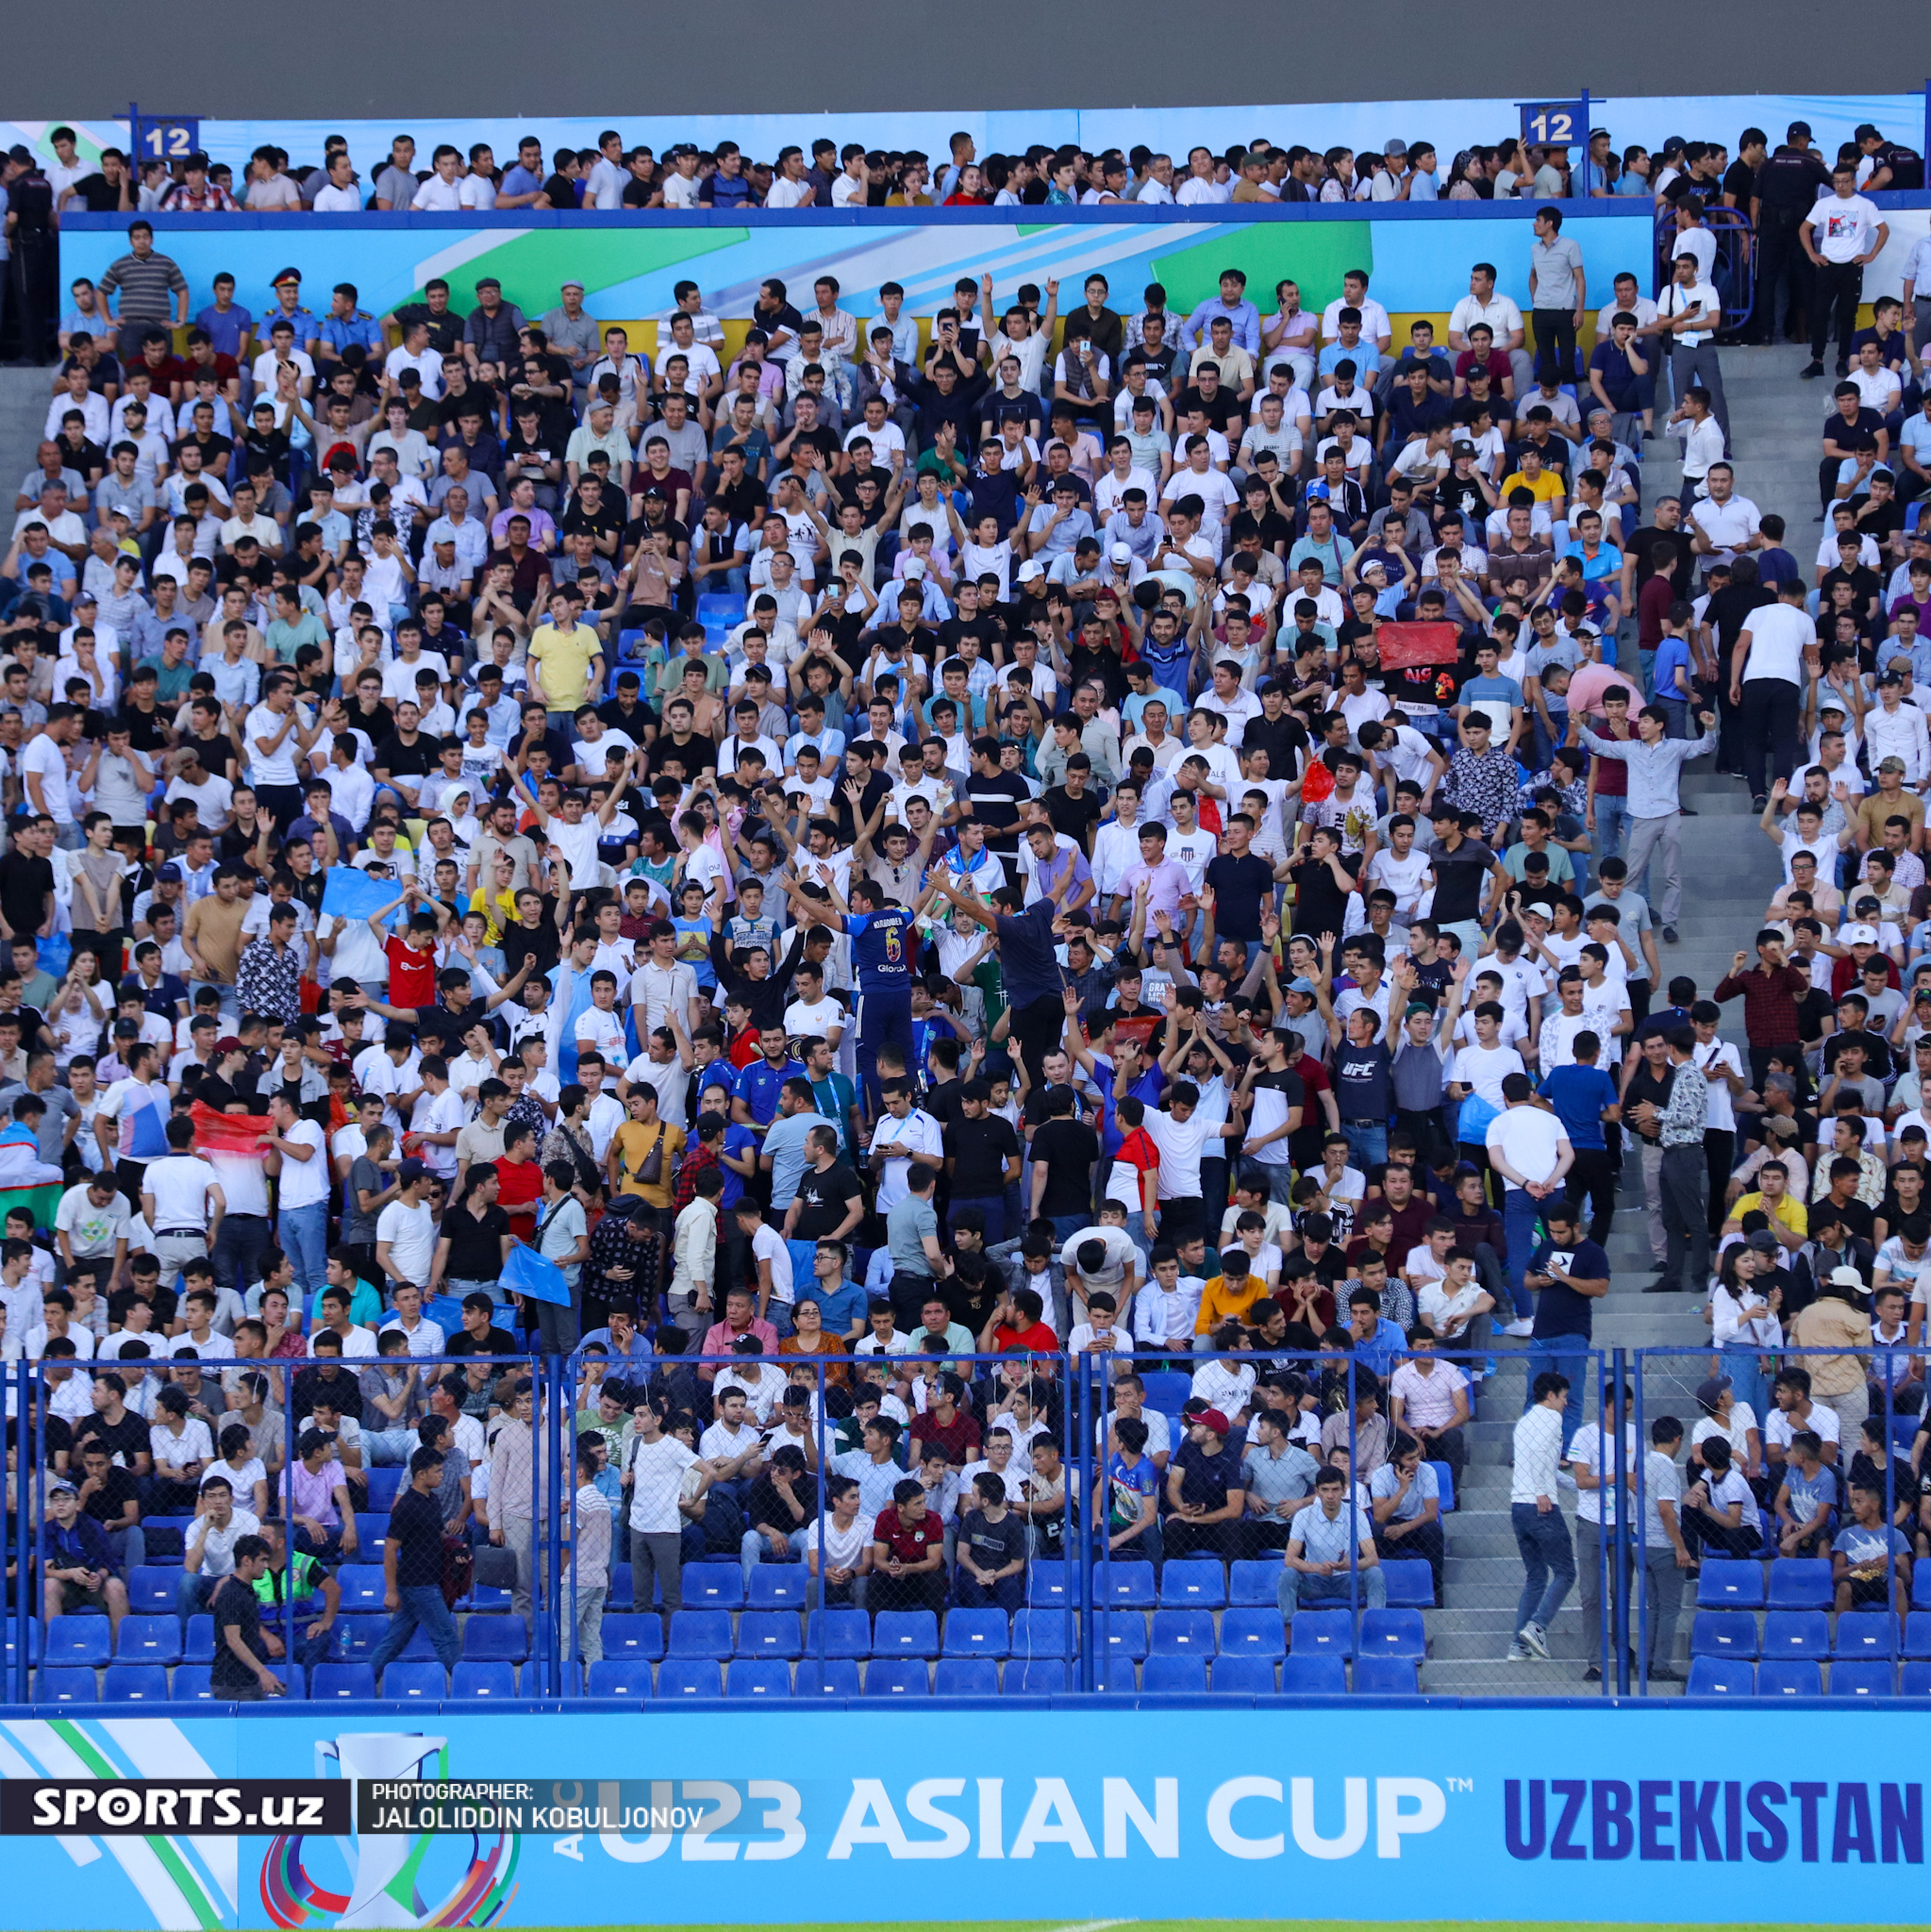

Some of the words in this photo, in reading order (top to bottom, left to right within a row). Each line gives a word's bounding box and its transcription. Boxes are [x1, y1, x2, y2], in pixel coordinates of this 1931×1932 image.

[145, 127, 191, 157] 12
[1530, 113, 1573, 142] 12
[885, 925, 902, 963] 6
[1341, 1061, 1375, 1077] UFC
[596, 1779, 807, 1863] U23
[826, 1777, 1179, 1859] ASIAN
[1504, 1778, 1924, 1864] UZBEKISTAN
